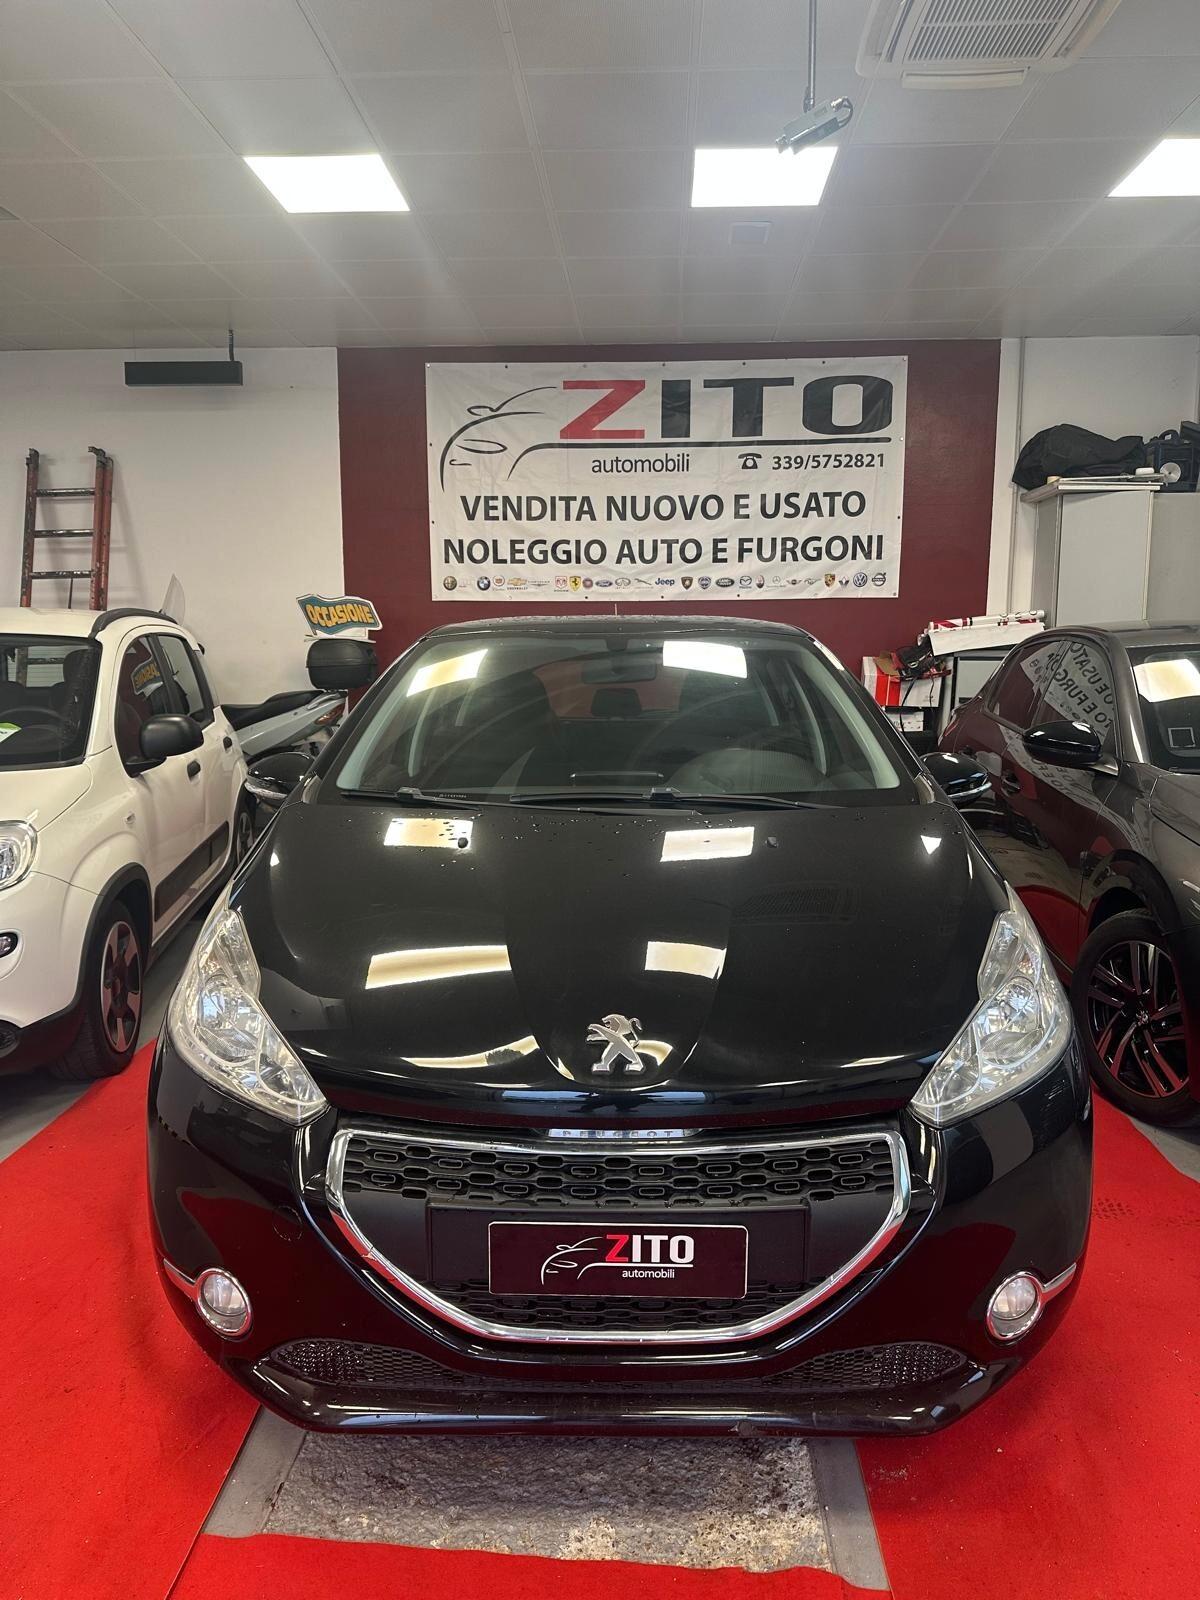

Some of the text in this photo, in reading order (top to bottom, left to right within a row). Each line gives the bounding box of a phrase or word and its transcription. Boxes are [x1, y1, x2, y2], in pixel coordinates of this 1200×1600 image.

[561, 375, 893, 438] ZITO
[592, 453, 690, 473] automobili
[772, 454, 884, 471] 339/5752821
[460, 491, 865, 521] VENDITA NUOVO E USATO
[444, 535, 883, 565] NOLEGGIO AUTO E FURGONI
[655, 578, 675, 586] Jeep
[306, 604, 374, 627] OCCASIONE
[605, 1234, 695, 1263] ZITO
[622, 1269, 675, 1279] automobili
